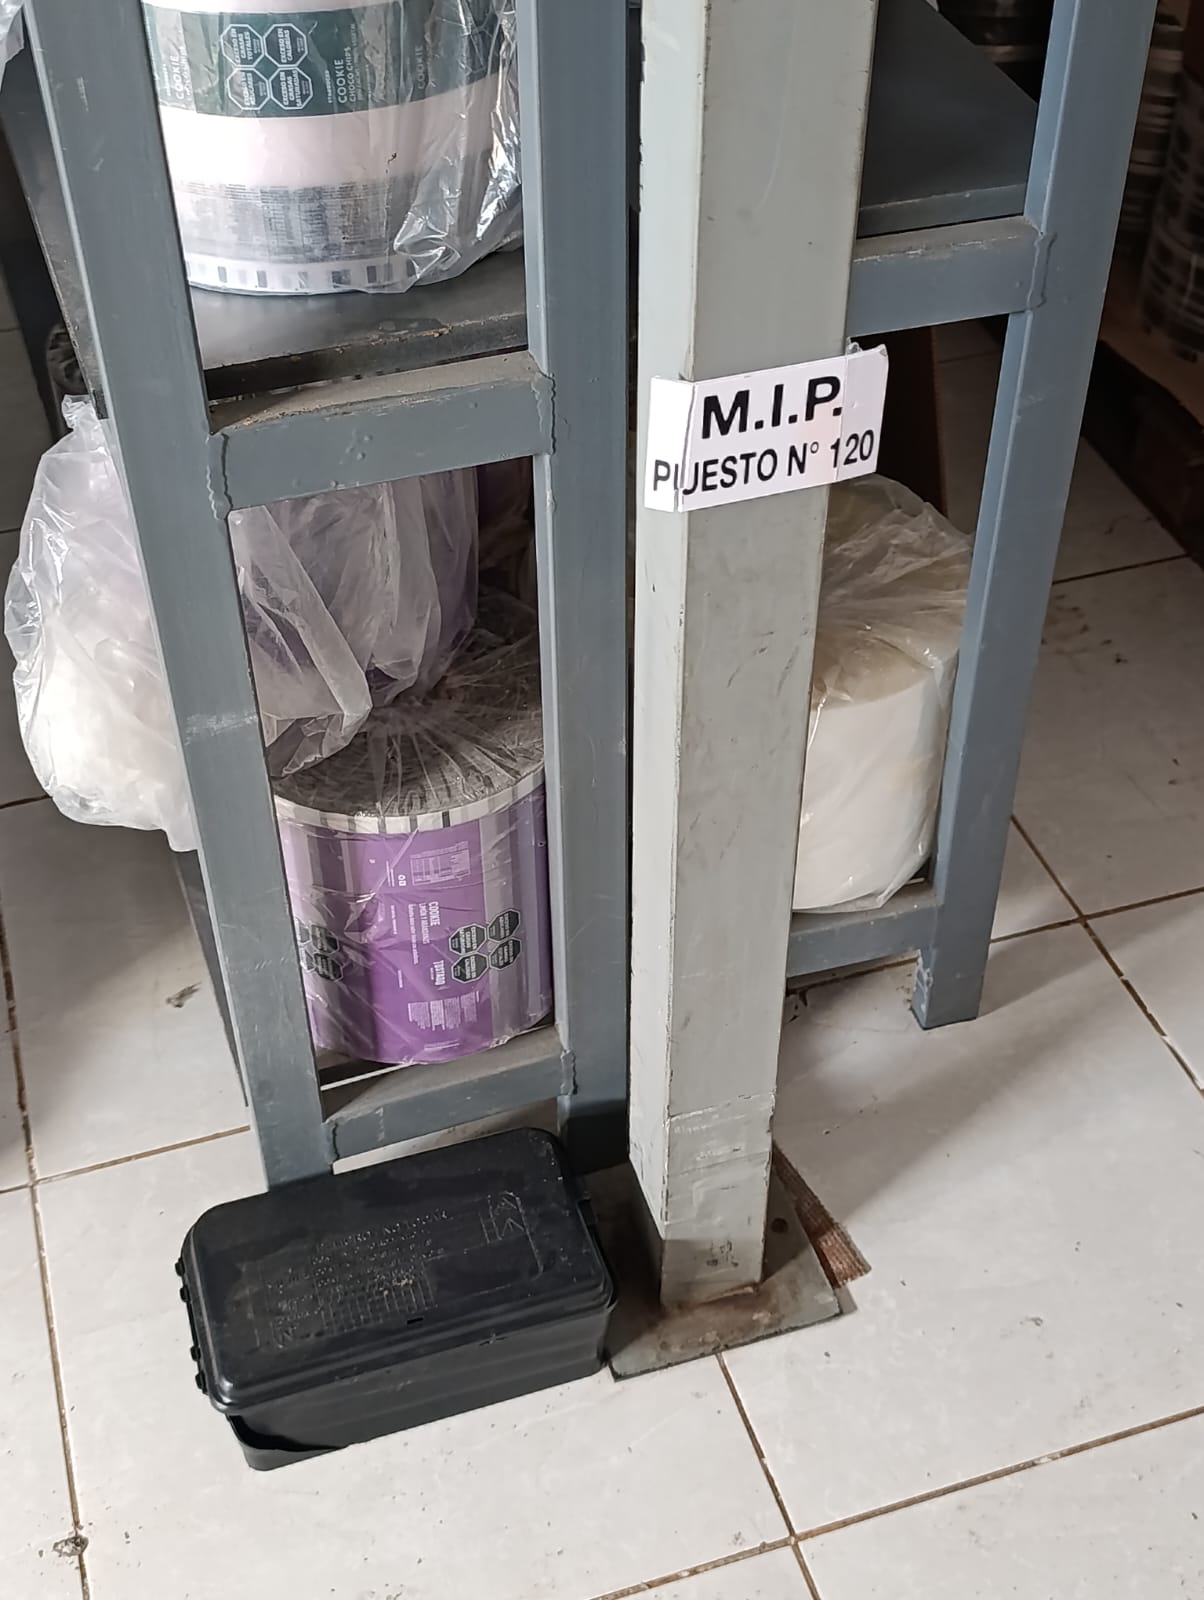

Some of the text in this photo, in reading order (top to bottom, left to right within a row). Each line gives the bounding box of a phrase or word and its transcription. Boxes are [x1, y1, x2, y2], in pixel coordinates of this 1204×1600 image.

[334, 59, 347, 103] COOKIE
[344, 46, 356, 102] CHOCO CHIPS
[415, 45, 425, 89] COOKIE
[702, 376, 843, 439] M.I.P.
[653, 448, 778, 496] PUESTO
[830, 430, 874, 468] 120
